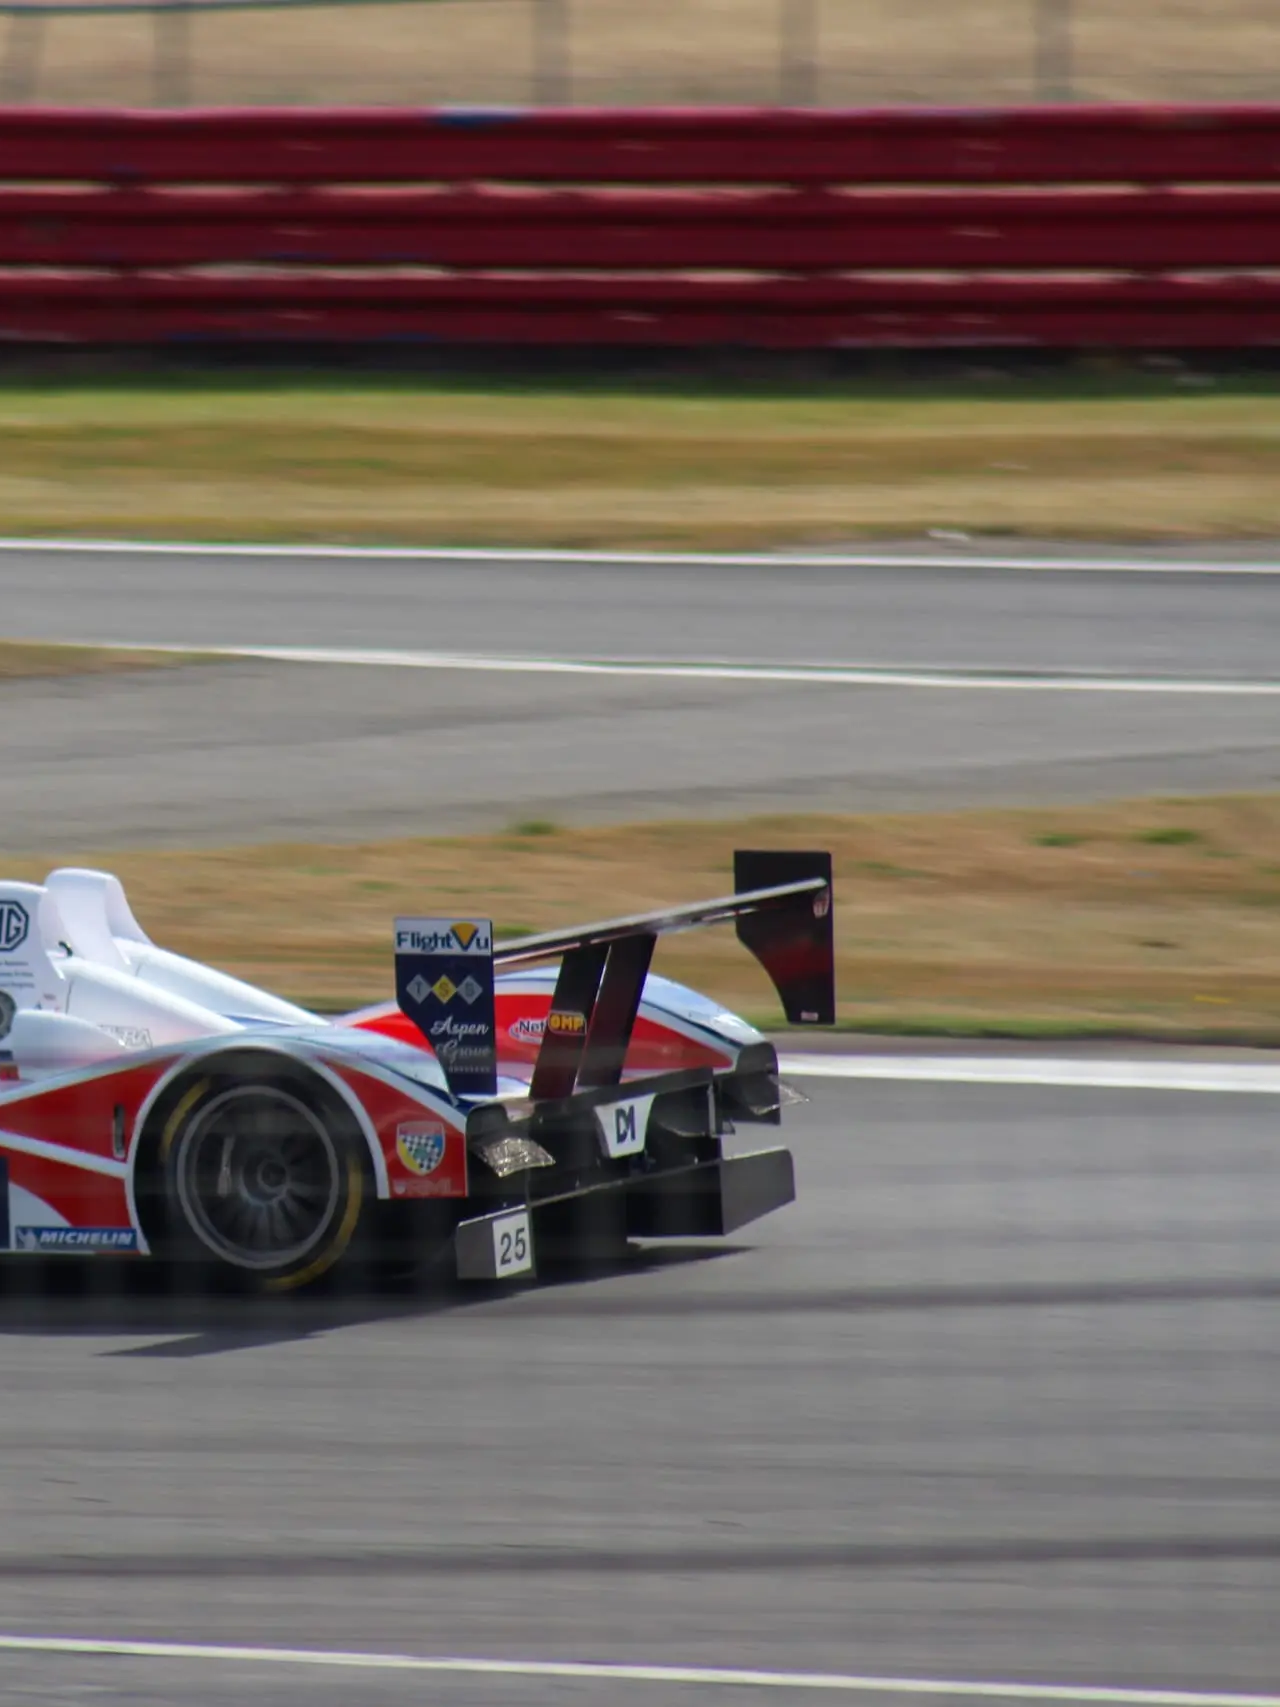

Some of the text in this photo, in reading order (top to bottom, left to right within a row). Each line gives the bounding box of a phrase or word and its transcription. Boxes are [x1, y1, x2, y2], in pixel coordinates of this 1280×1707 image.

[397, 922, 489, 952] FlightVu
[430, 1014, 489, 1041] Aspen
[550, 1013, 584, 1031] OMP
[40, 1229, 133, 1246] MICHELIN
[500, 1227, 526, 1266] 25
